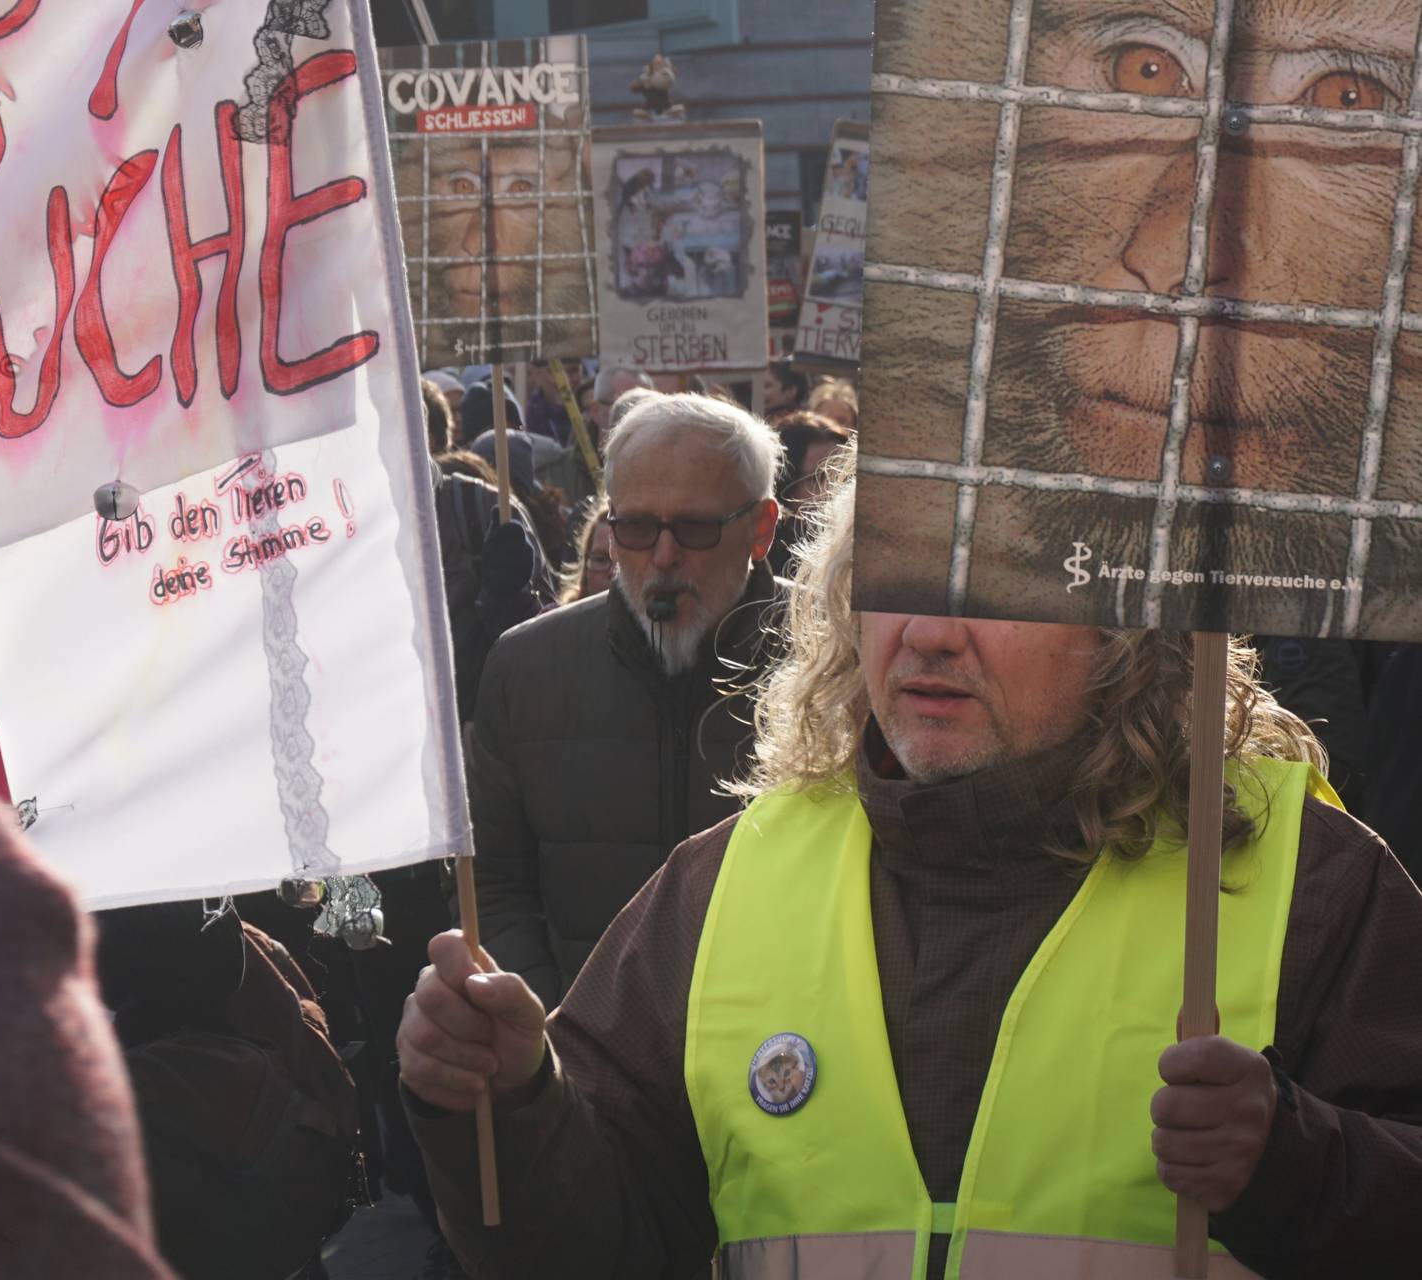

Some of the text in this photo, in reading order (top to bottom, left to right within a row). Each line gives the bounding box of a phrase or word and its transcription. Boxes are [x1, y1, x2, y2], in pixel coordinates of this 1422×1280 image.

[388, 62, 579, 114] COVANCE
[425, 107, 527, 131] SCHLIESSEN!
[633, 332, 729, 364] STERBEN
[96, 452, 307, 565] Gib den Tieren
[150, 556, 212, 605] deine
[1098, 560, 1364, 592] Ärzte gegen Tierversuche e.V.
